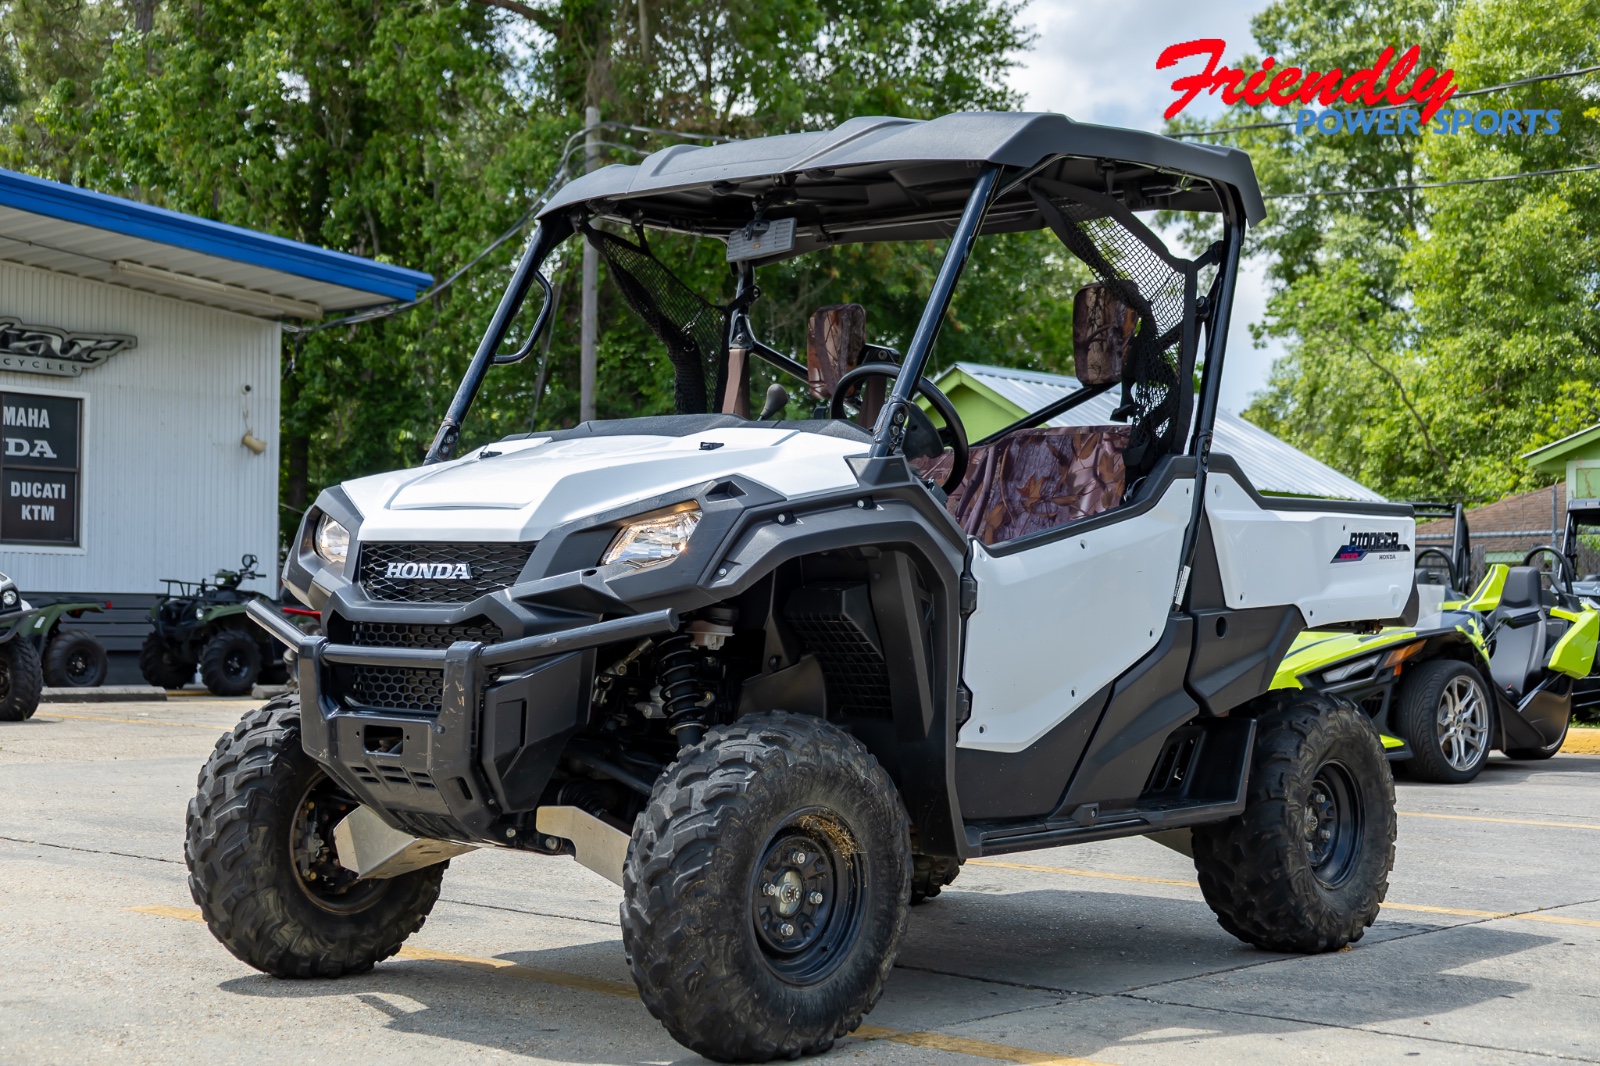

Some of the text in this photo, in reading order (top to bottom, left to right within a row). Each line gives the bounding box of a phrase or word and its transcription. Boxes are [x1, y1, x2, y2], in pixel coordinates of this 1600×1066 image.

[3, 357, 78, 373] CYCLES
[10, 481, 66, 500] DUCATI
[21, 504, 55, 522] KTM
[1348, 532, 1399, 551] PIONEER
[385, 562, 472, 580] HONDA
